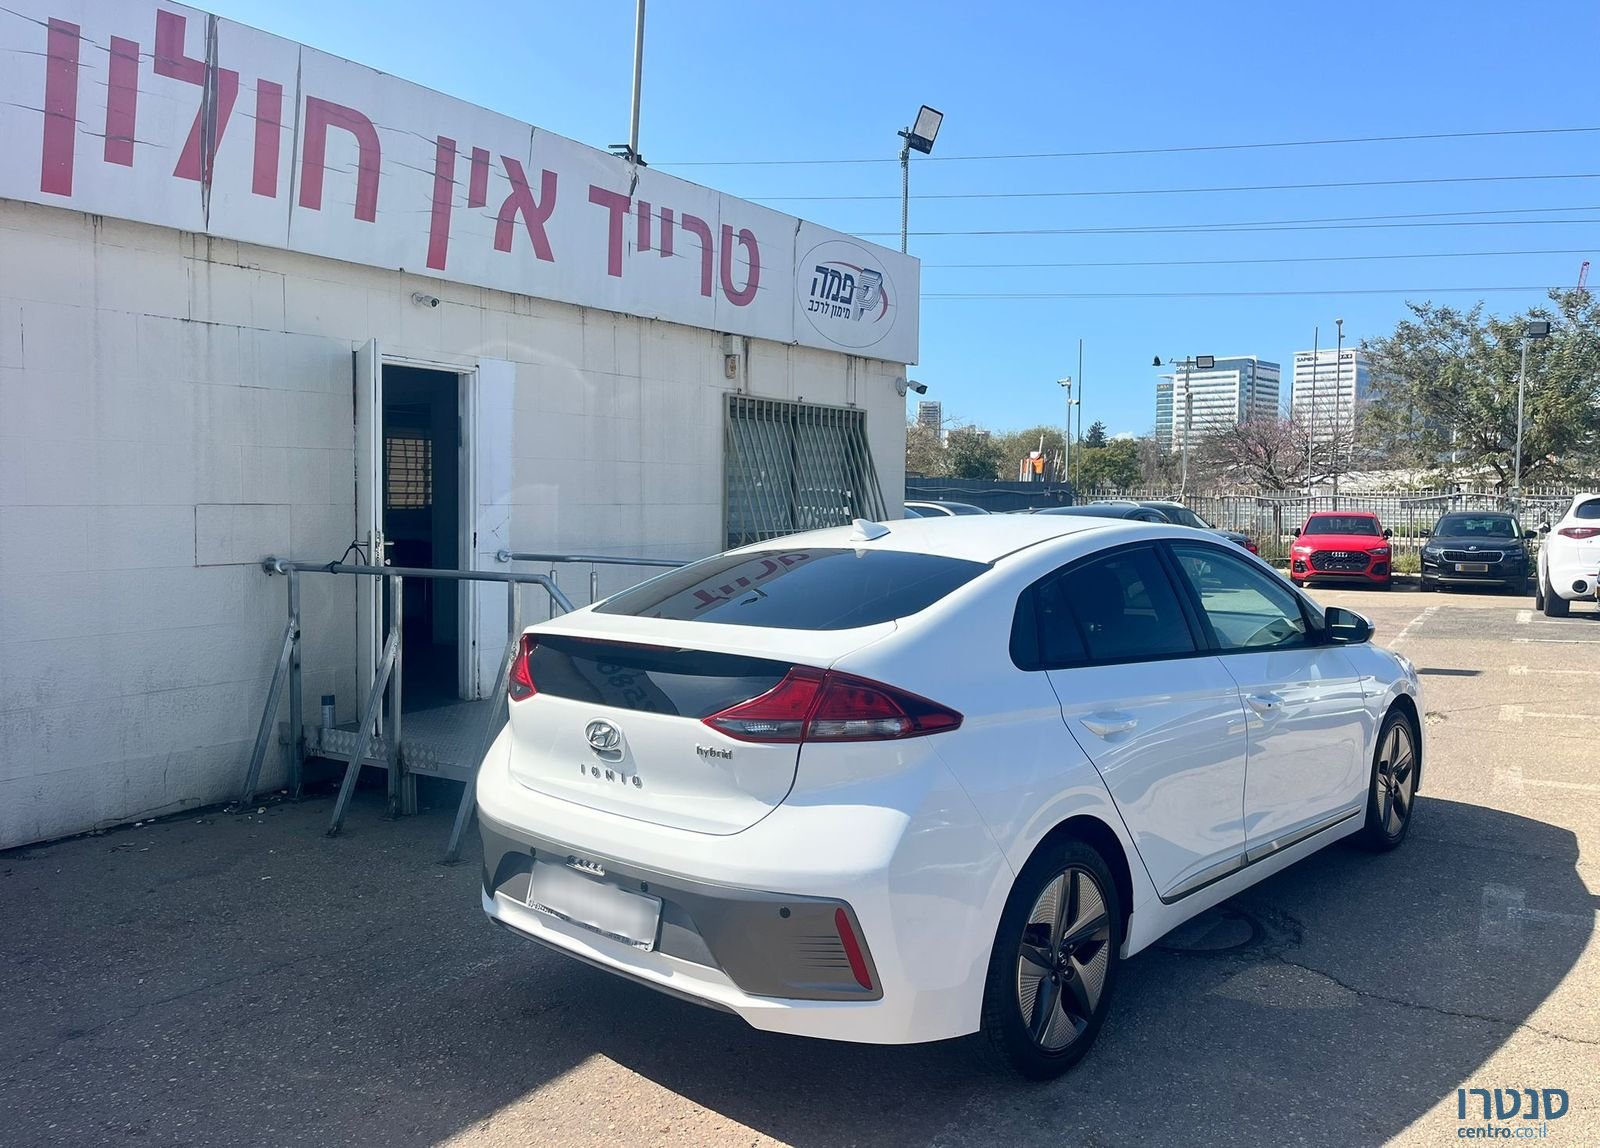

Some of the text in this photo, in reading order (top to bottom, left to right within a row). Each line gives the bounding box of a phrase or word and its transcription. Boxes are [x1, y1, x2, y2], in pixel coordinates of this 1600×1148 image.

[41, 8, 761, 307] טרייד אין חולון
[810, 265, 855, 305] פמה
[807, 299, 851, 319] מימון לרכב
[696, 743, 733, 760] hybrid
[580, 763, 643, 789] IONIQ
